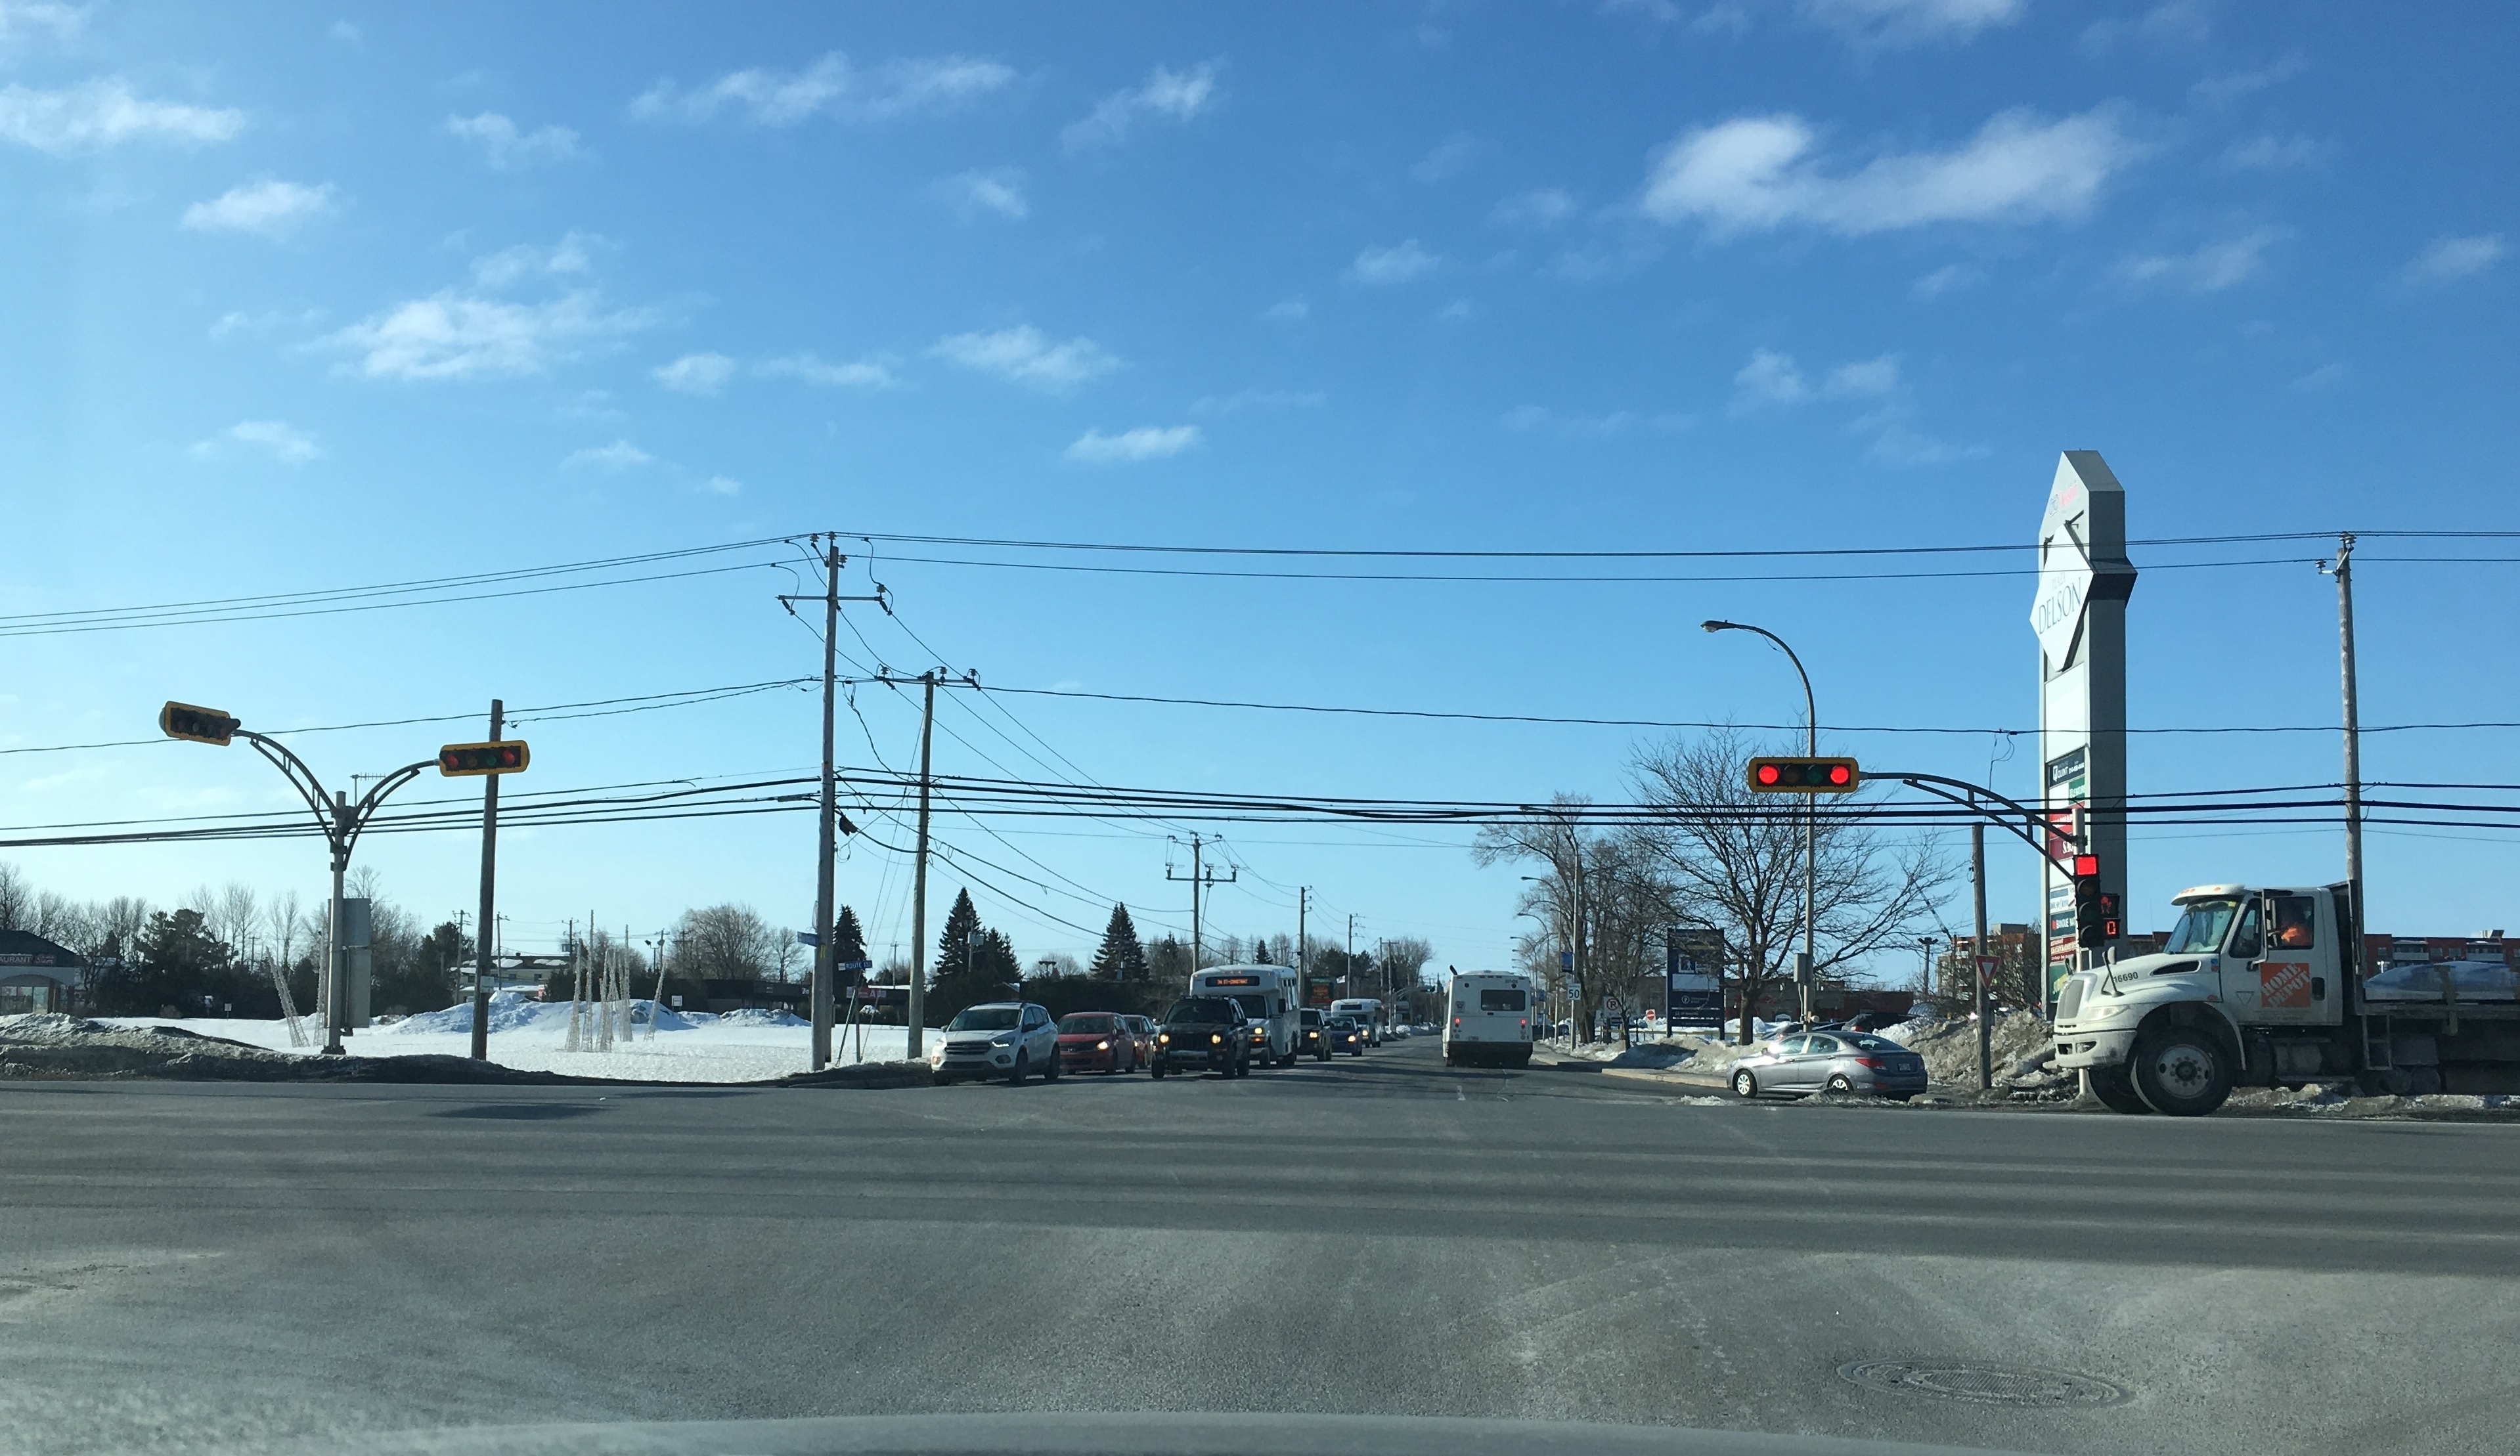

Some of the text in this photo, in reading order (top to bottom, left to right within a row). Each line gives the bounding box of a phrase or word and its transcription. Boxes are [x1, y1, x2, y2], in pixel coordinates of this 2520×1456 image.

[2039, 577, 2081, 634] DELSON
[1568, 988, 1580, 999] 50
[2113, 971, 2138, 983] 16690
[2261, 963, 2301, 996] HOME
[2268, 971, 2310, 1007] DEPOT
